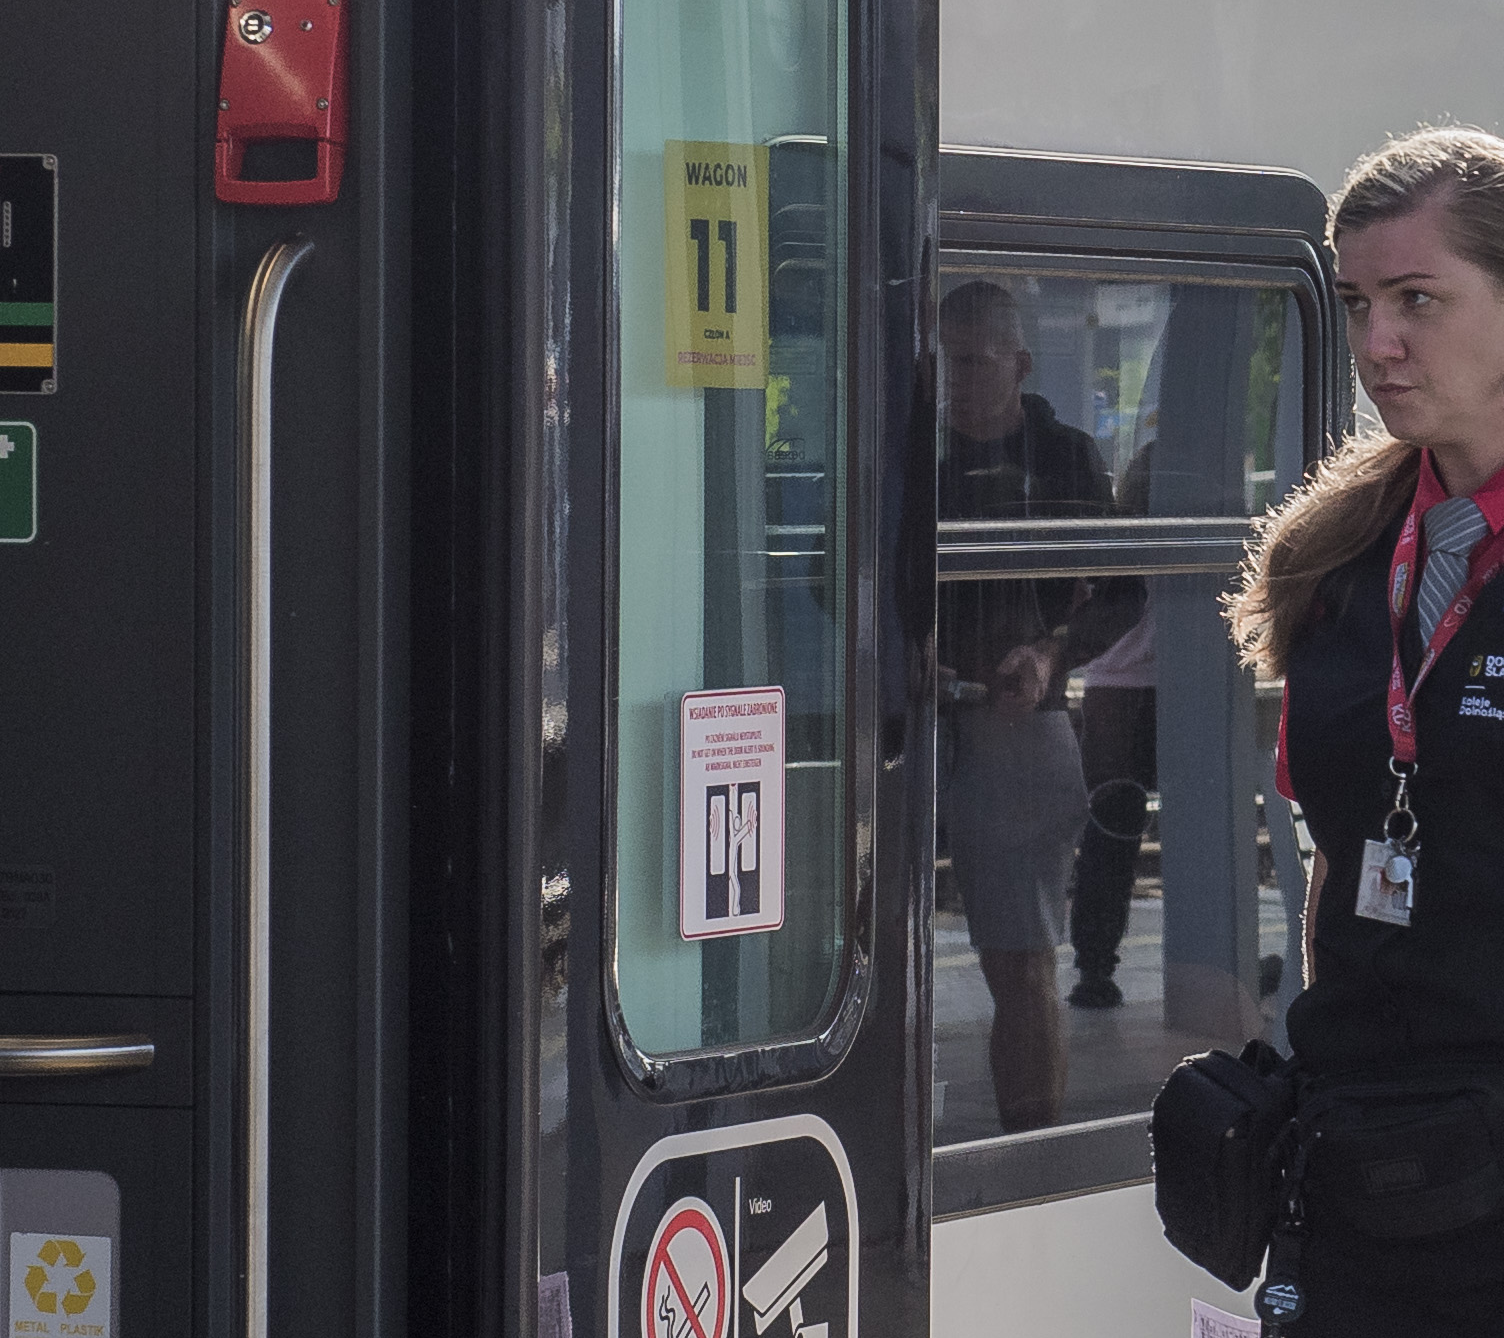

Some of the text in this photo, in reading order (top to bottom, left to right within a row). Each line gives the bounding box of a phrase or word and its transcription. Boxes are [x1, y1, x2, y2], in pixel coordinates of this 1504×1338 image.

[685, 162, 747, 189] WAGON
[690, 218, 738, 314] 11
[718, 705, 725, 718] PO
[748, 1197, 772, 1215] Video
[15, 1320, 105, 1337] METAL PLASTIK
